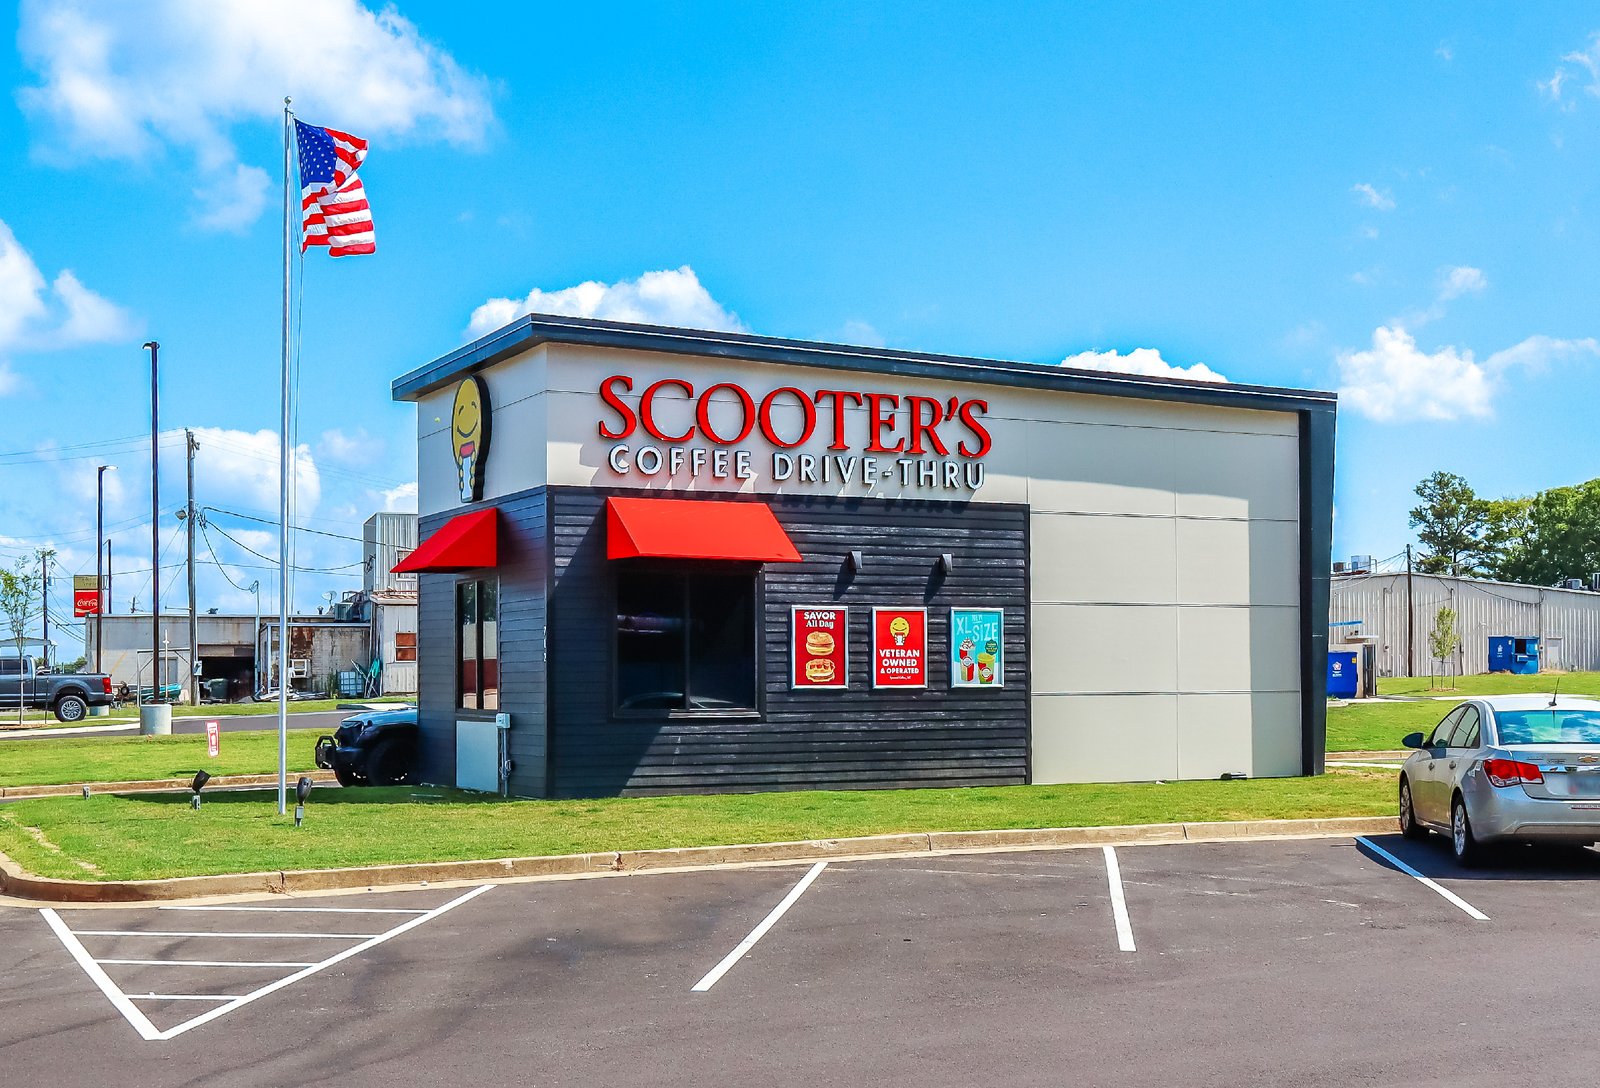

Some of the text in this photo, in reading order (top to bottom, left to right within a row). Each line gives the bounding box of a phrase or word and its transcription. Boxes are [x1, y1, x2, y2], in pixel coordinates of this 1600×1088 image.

[598, 375, 992, 458] SCOOTER'S
[608, 444, 985, 490] COFFEE DRIVE-THRU
[803, 611, 836, 620] SAVOR
[805, 620, 834, 630] All Day
[956, 616, 998, 642] XL SIZE
[879, 649, 920, 658] VETERAN
[882, 658, 918, 667] OWNED
